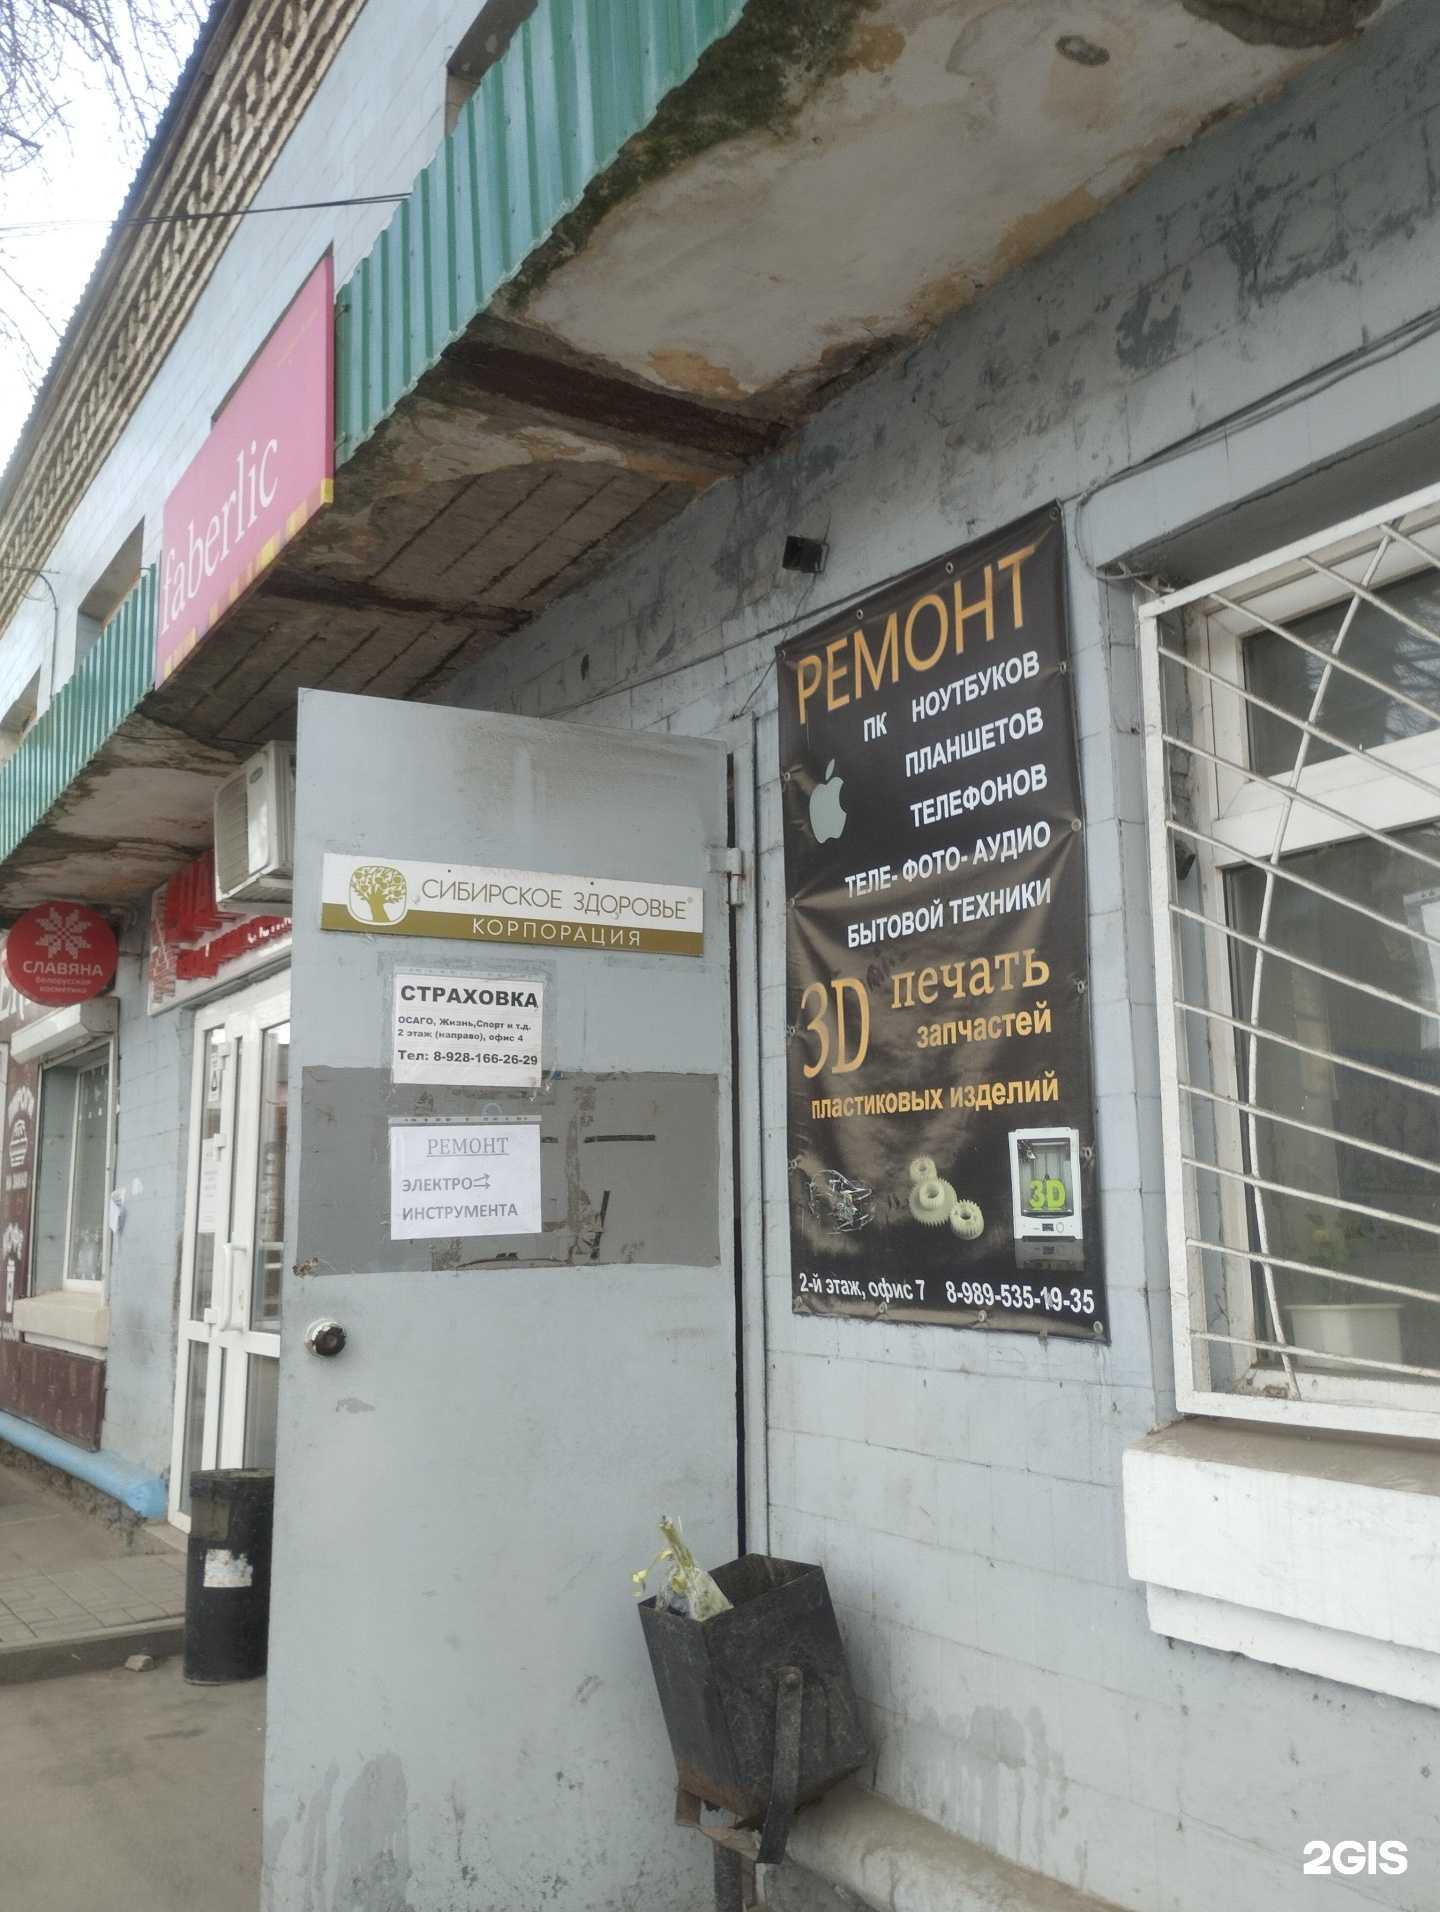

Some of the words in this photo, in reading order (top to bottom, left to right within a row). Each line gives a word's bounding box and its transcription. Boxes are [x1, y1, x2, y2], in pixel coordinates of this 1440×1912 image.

[161, 438, 278, 635] faberlic
[796, 544, 1036, 725] РЕМОНТ
[863, 711, 888, 742] ПК
[911, 649, 1041, 723] НОУТБУКОВ
[905, 706, 1044, 778] ПЛАНШЕТОВ
[910, 763, 1048, 828] ТЕЛЕФОНОВ
[845, 864, 898, 899] ТЕЛЕ-
[902, 845, 968, 884] ФОТО-
[972, 820, 1051, 866] АУДИО
[421, 878, 562, 911] СИБИРСКОЕ
[573, 891, 688, 921] ЗДОРОВЬЕ
[847, 900, 944, 949] БЫТОВОЙ
[949, 877, 1052, 925] ТЕХНИКИ
[472, 918, 641, 947] КОРПОРАЦИЯ
[23, 960, 103, 977] СЛАВЯНА
[400, 985, 539, 1008] СТРАХОВКА
[801, 976, 870, 1080] 3D
[891, 947, 1050, 1009] печать
[397, 1016, 437, 1026] ОСАГО,
[397, 1028, 404, 1037] 2
[406, 1030, 433, 1038] этаж
[435, 1030, 486, 1042] (направо),
[488, 1033, 515, 1043] офис
[517, 1034, 523, 1042] 4
[916, 1000, 1052, 1049] запчастей
[397, 1050, 429, 1061] Тел:
[433, 1051, 538, 1065] 8-928-166-26-29
[811, 1087, 944, 1120] пластиковых
[950, 1071, 1060, 1111] изделий
[427, 1137, 509, 1156] РЕМОНТ
[402, 1177, 473, 1192] ЭЛЕКТРО
[1029, 1178, 1066, 1211] 3D
[402, 1203, 519, 1220] ИНСТРУМЕНТА
[799, 1272, 822, 1293] 2-й
[825, 1277, 866, 1299] этаж,
[868, 1277, 914, 1305] офис
[915, 1279, 926, 1300] 7
[946, 1280, 1095, 1315] 8-989-535-19-35
